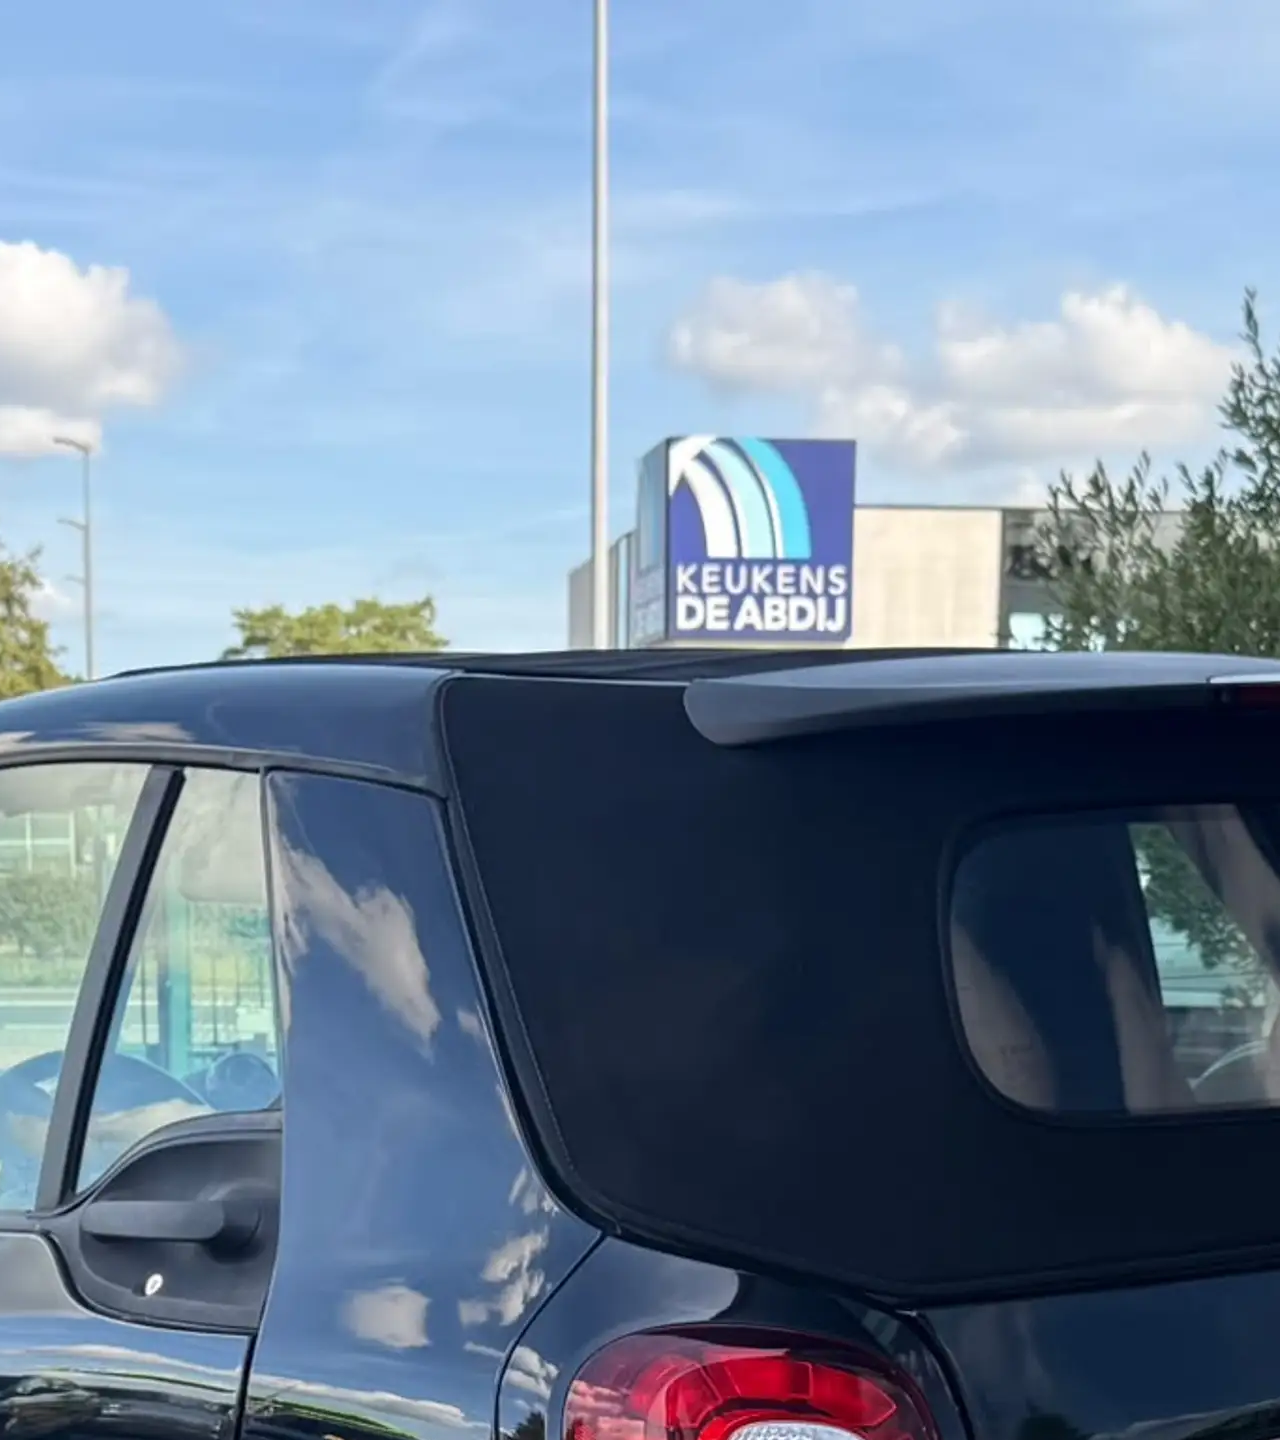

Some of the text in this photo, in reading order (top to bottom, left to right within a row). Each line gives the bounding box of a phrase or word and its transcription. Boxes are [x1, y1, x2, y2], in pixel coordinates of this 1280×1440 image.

[676, 564, 848, 595] KEUKENS
[677, 598, 730, 631] DE
[734, 598, 846, 632] ABDIJ
